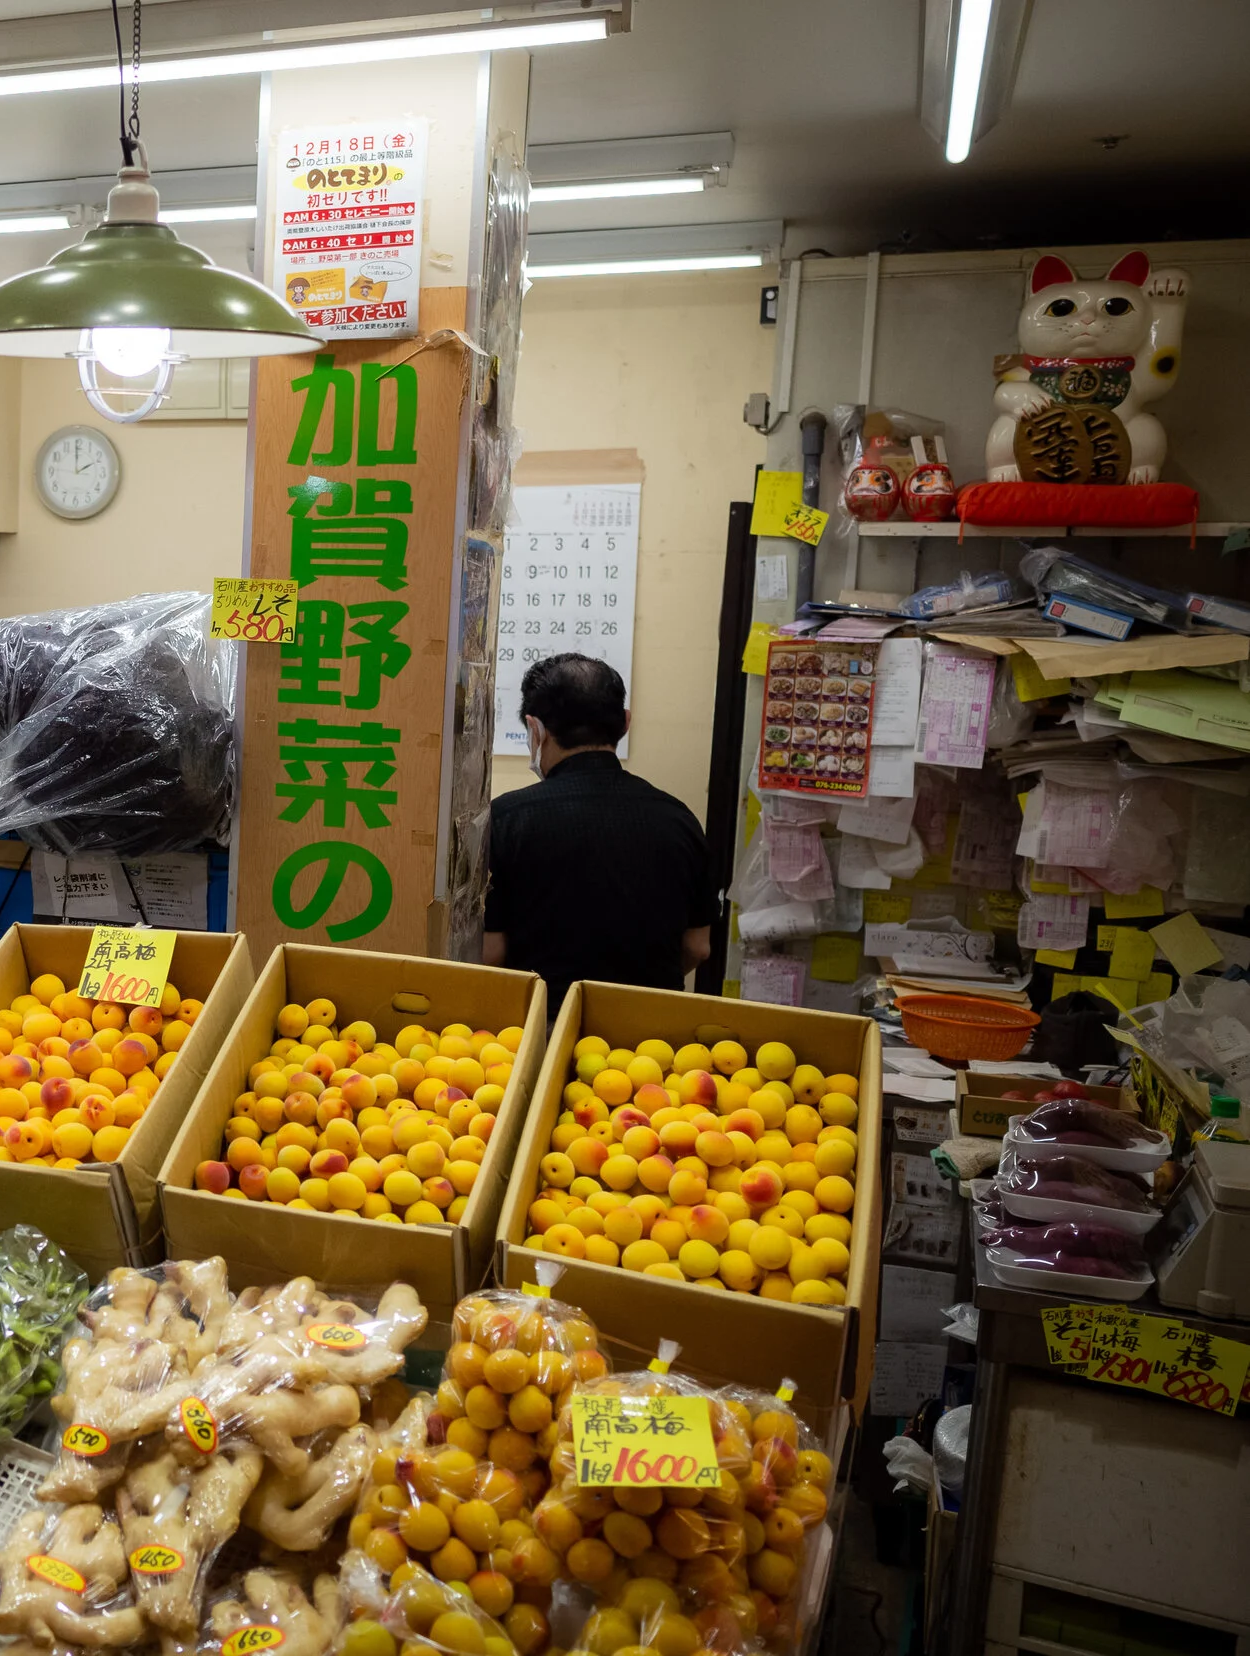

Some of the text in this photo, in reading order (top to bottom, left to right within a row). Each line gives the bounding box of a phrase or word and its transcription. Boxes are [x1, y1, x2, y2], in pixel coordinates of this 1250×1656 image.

[293, 214, 310, 223] AM
[291, 240, 308, 250] AM
[1067, 369, 1099, 394] 福
[505, 537, 616, 551] 1 2 3 4 5
[502, 565, 619, 580] 8 9 10 11 12
[215, 581, 296, 594] 石川産 おすすめ品
[214, 593, 293, 616] ちりめん しそ
[500, 593, 618, 608] 15 16 17 18 19
[499, 620, 618, 636] 22 23 24 25 26
[272, 353, 418, 943] 加賀野菜の
[498, 648, 540, 663] 29 30
[94, 939, 157, 961] 南高梅
[1161, 1326, 1214, 1349] 石川産
[1176, 1345, 1223, 1372] 梅
[584, 1410, 693, 1437] 南高梅
